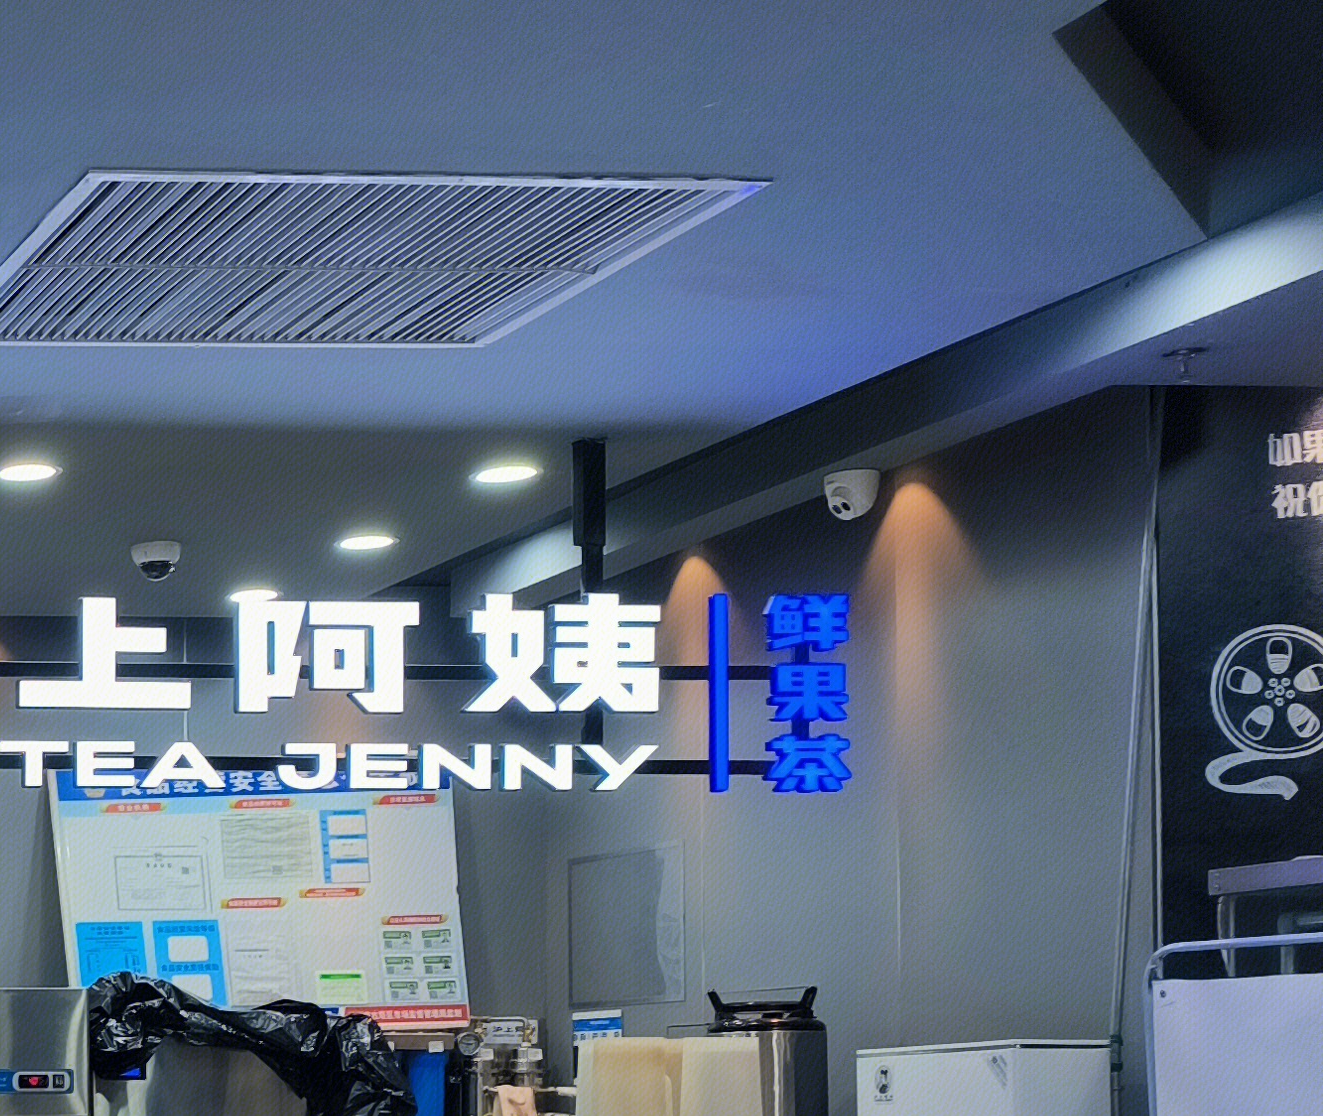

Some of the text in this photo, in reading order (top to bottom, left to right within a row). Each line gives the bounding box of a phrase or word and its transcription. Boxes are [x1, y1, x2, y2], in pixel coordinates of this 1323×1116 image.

[762, 593, 852, 793] 鲜果茶
[276, 742, 659, 790] JENNY
